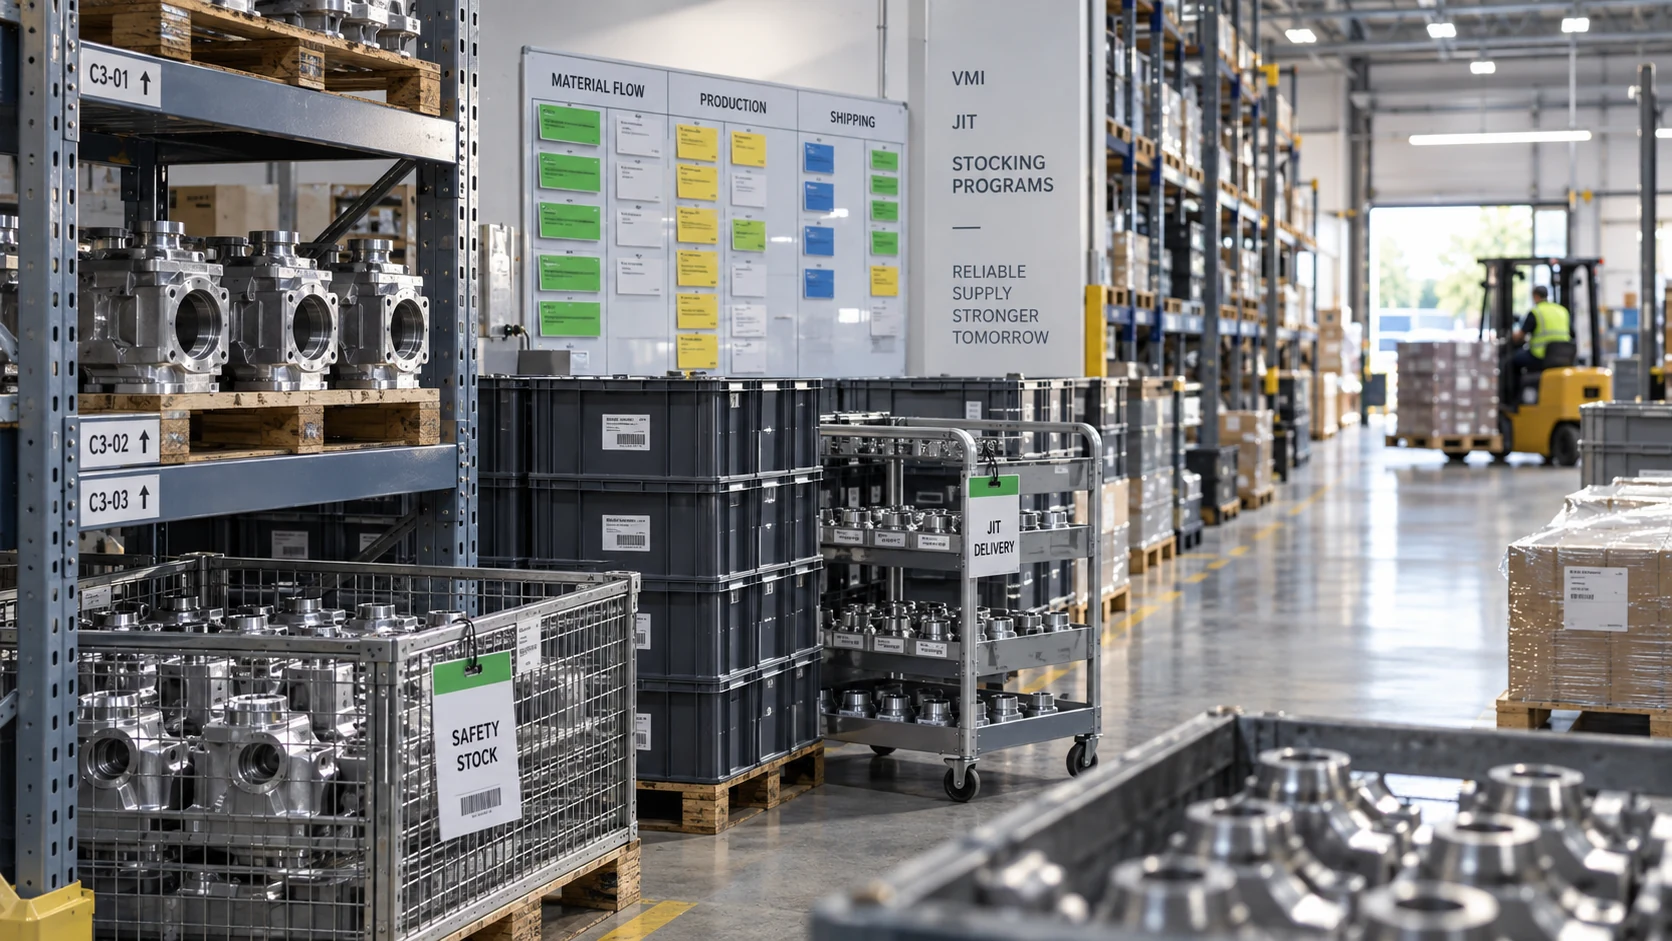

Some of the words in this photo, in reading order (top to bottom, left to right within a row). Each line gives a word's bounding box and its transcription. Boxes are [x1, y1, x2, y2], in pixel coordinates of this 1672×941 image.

[89, 63, 128, 89] C3-01
[952, 71, 985, 86] VMI
[551, 73, 611, 94] MATERIAL
[613, 81, 645, 98] FLOW
[699, 92, 767, 114] PRODUCTION
[830, 110, 876, 129] SHIPPING
[952, 114, 978, 130] JIT
[952, 155, 1046, 172] STOCKING
[952, 177, 1054, 194] PROGRAMS
[952, 264, 1027, 279] RELIABLE
[952, 286, 1013, 301] SUPPLY
[952, 308, 1039, 323] STRONGER
[952, 330, 1050, 345] TOMORROW
[89, 434, 128, 455] C3-02
[89, 489, 129, 512] C3-03
[987, 520, 1002, 535] JIT
[974, 540, 1015, 557] DELIVERY
[452, 720, 500, 747] SAFETY
[456, 747, 498, 772] STOCK
